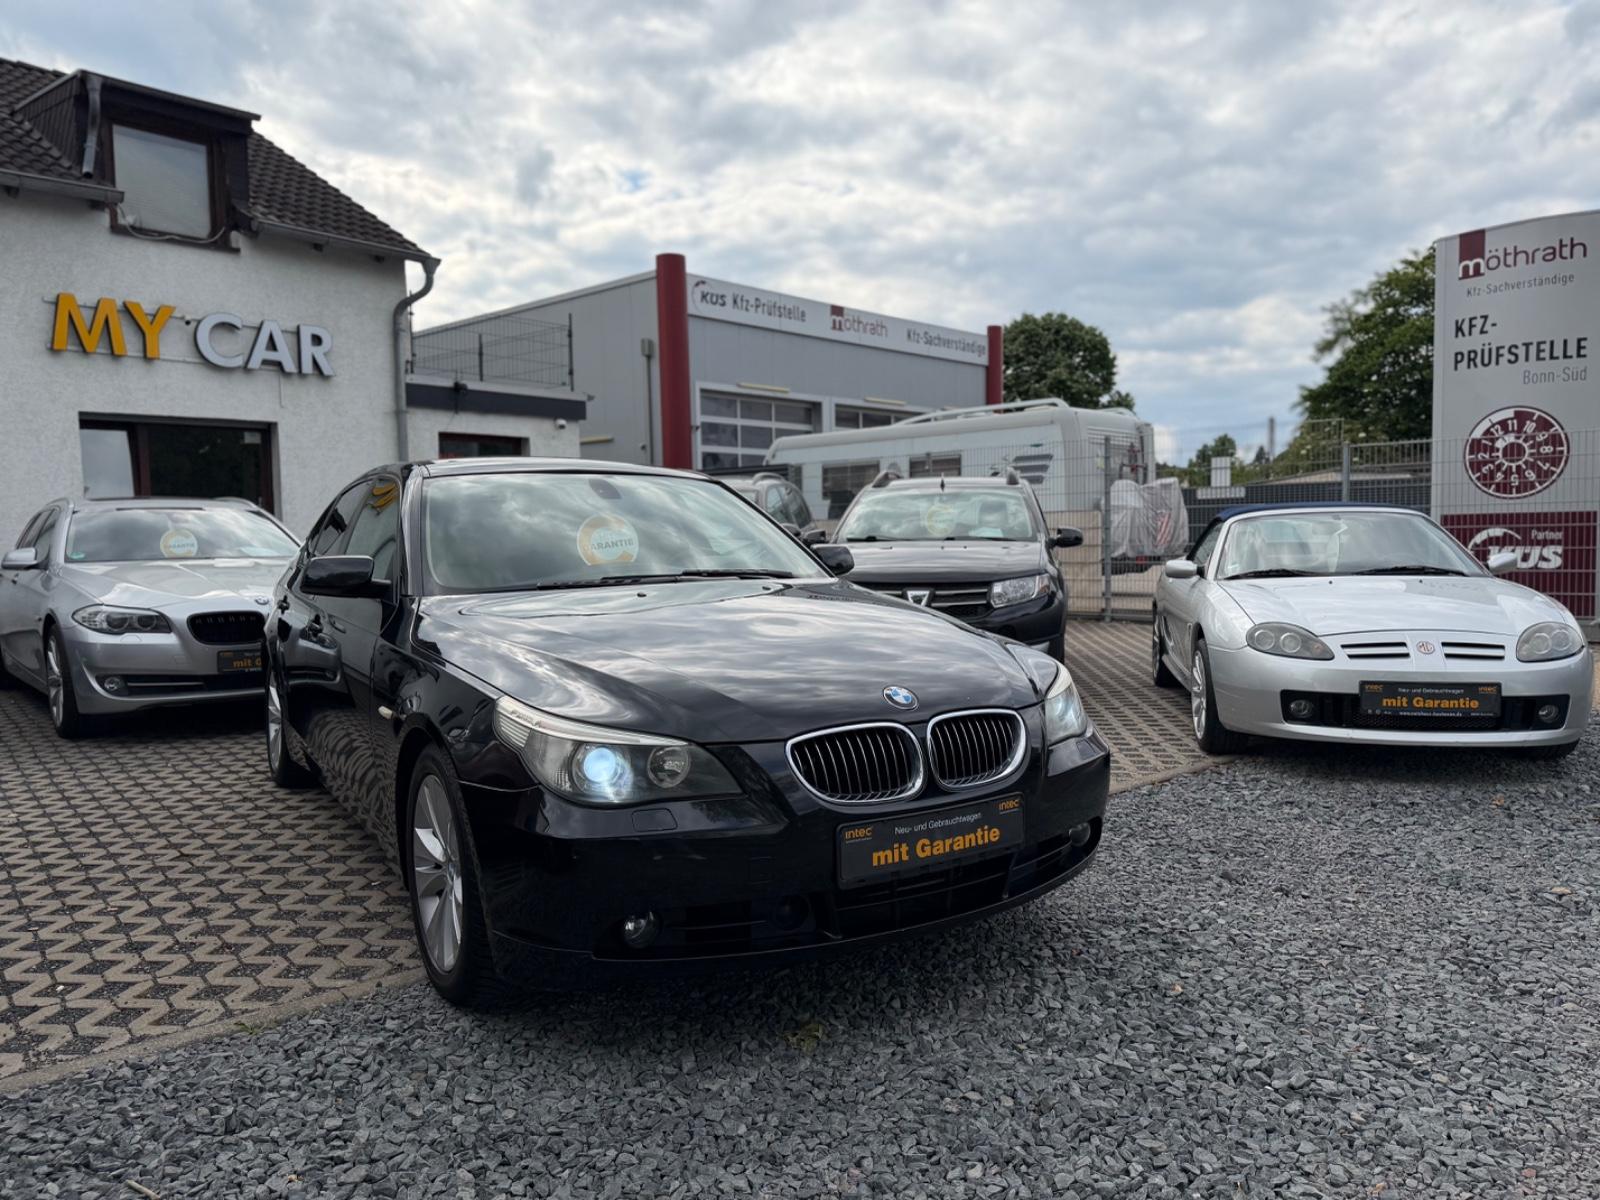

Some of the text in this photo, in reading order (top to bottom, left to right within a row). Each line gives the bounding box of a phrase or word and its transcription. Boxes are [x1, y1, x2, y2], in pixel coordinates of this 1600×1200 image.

[732, 292, 807, 322] Kfz-Prüfstelle
[51, 292, 336, 378] MY CAR
[1454, 314, 1497, 339] KFZ-
[1453, 337, 1588, 371] PRÜFSTELLE
[1522, 366, 1588, 385] Bonn-Süd
[1490, 424, 1504, 437] 12
[1507, 419, 1517, 432] 11
[1523, 420, 1536, 433] 10
[1531, 529, 1564, 540] Partner
[1382, 696, 1479, 709] mit Garantie
[913, 821, 927, 831] und
[872, 825, 1000, 867] mit Garantie
